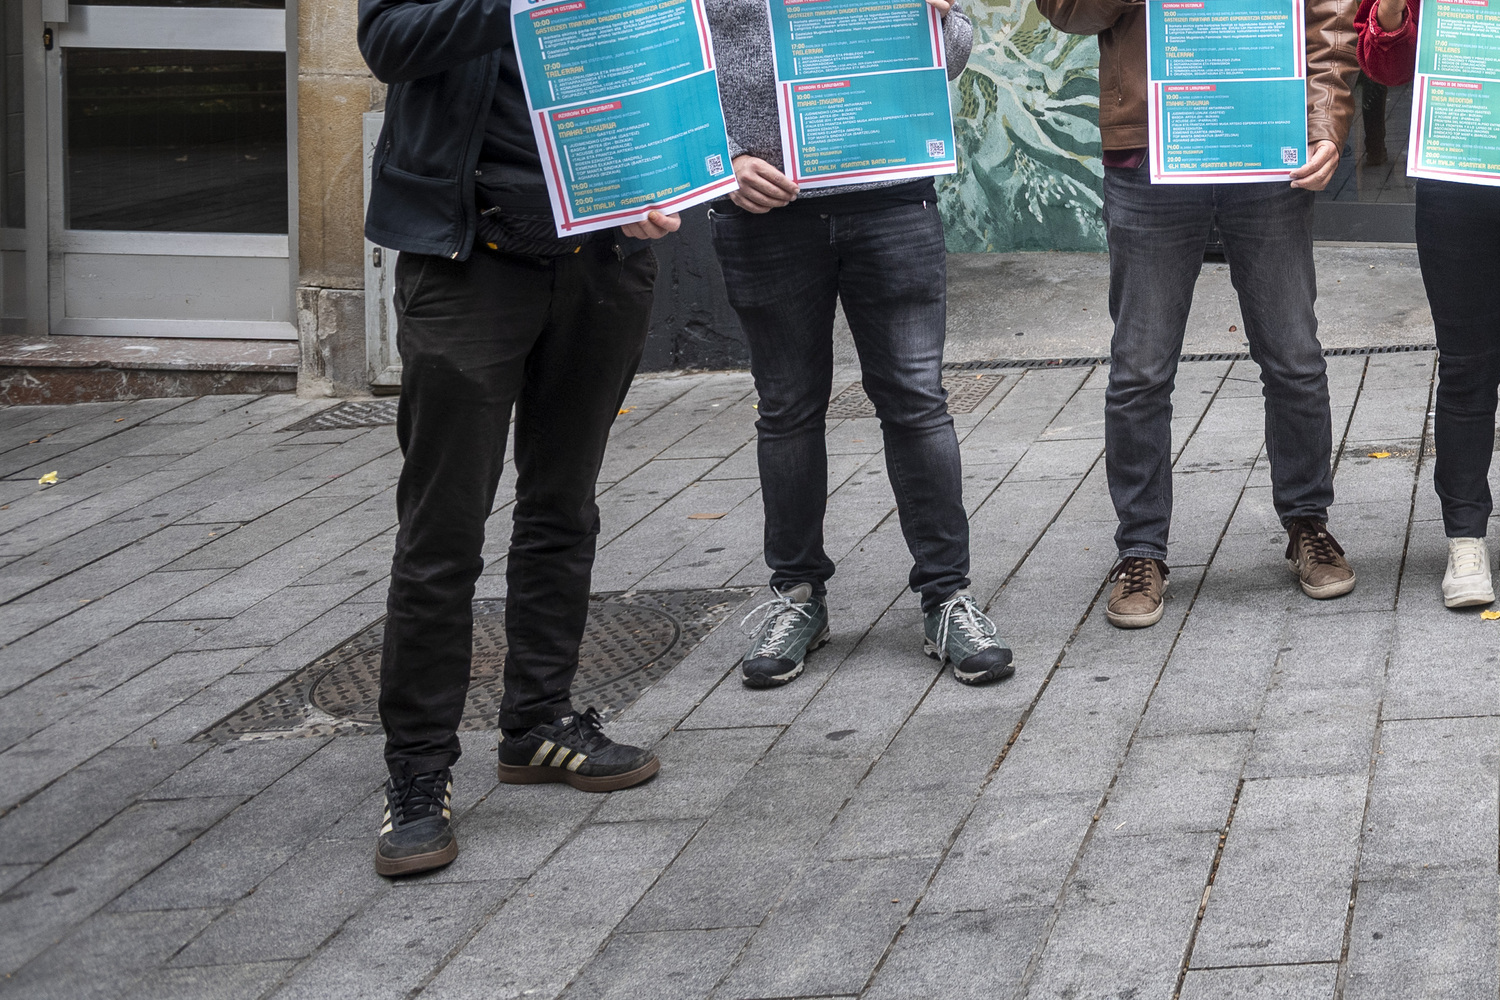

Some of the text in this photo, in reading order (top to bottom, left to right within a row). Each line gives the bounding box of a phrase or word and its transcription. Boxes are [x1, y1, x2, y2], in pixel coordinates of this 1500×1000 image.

[532, 18, 551, 28] 10:00
[791, 42, 805, 50] 17:00
[543, 62, 561, 72] 17:00
[556, 120, 574, 130] 10:00
[570, 181, 588, 191] 14:00
[574, 196, 594, 206] 20:00
